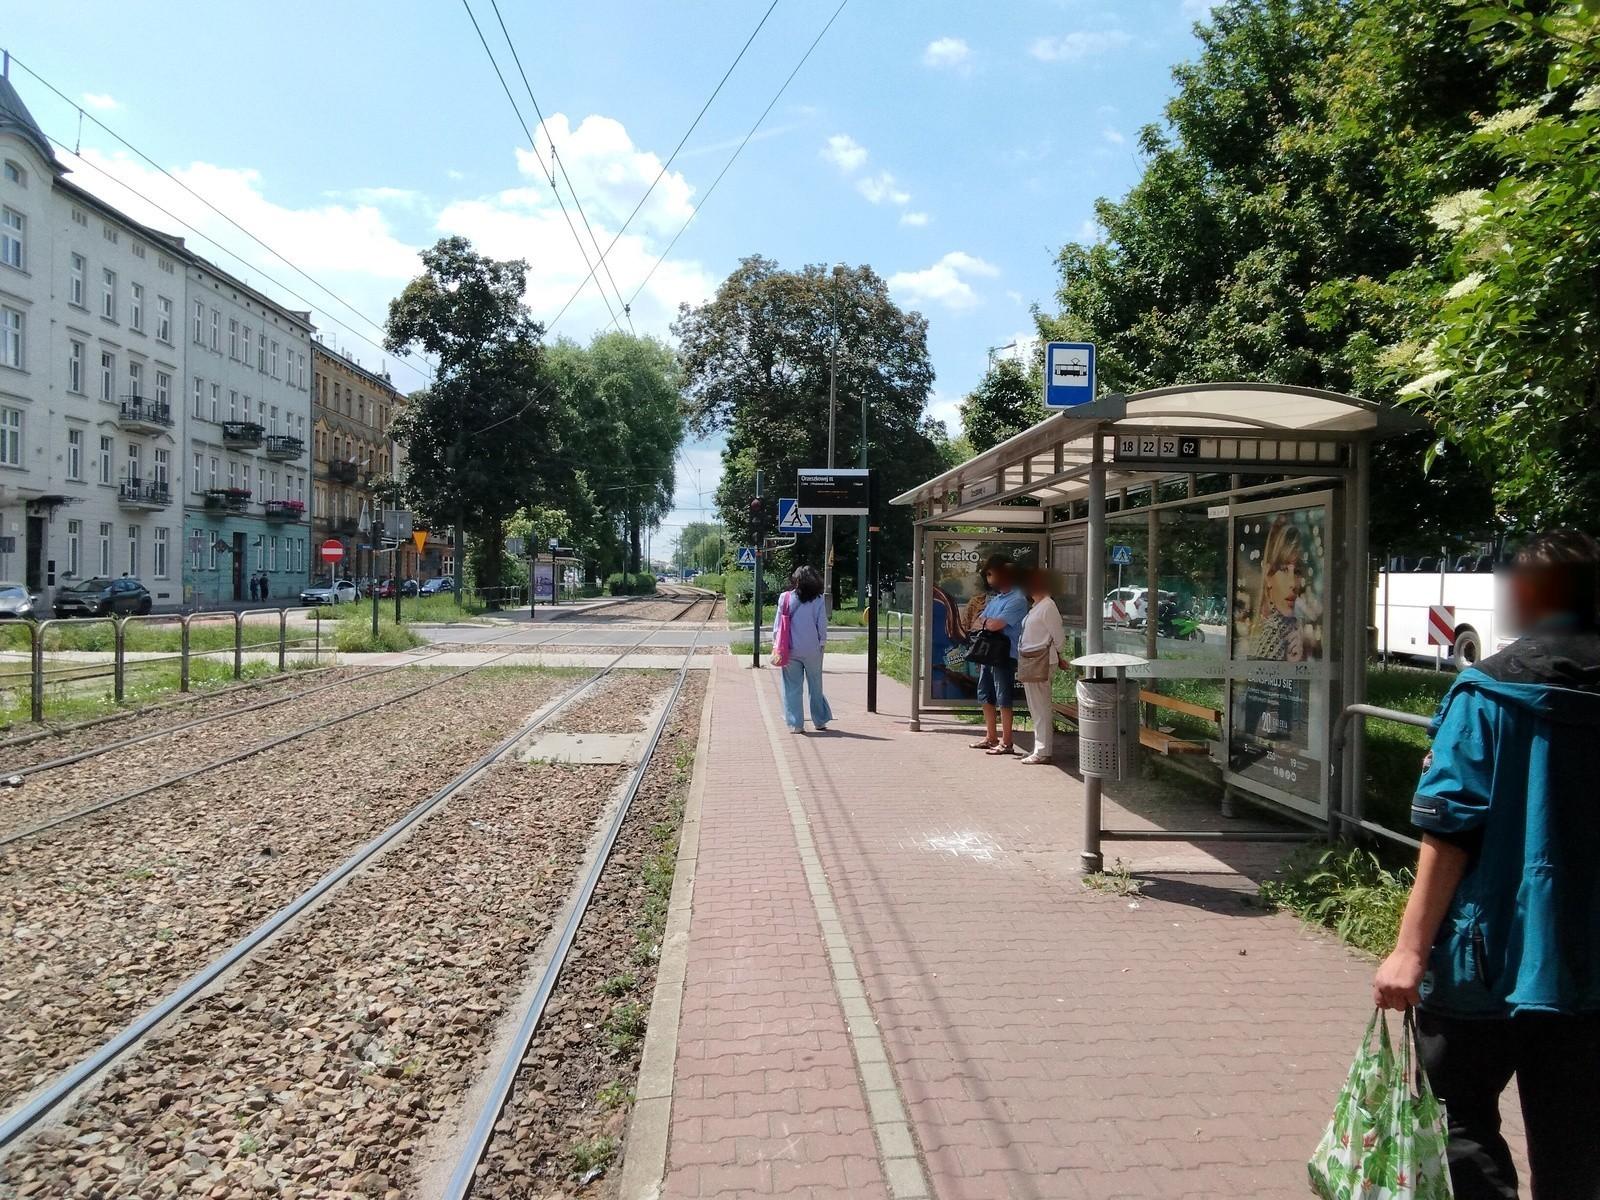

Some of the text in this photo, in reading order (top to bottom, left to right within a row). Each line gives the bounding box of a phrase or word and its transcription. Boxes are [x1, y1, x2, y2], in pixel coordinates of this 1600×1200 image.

[1122, 441, 1195, 454] 18 22 52 62
